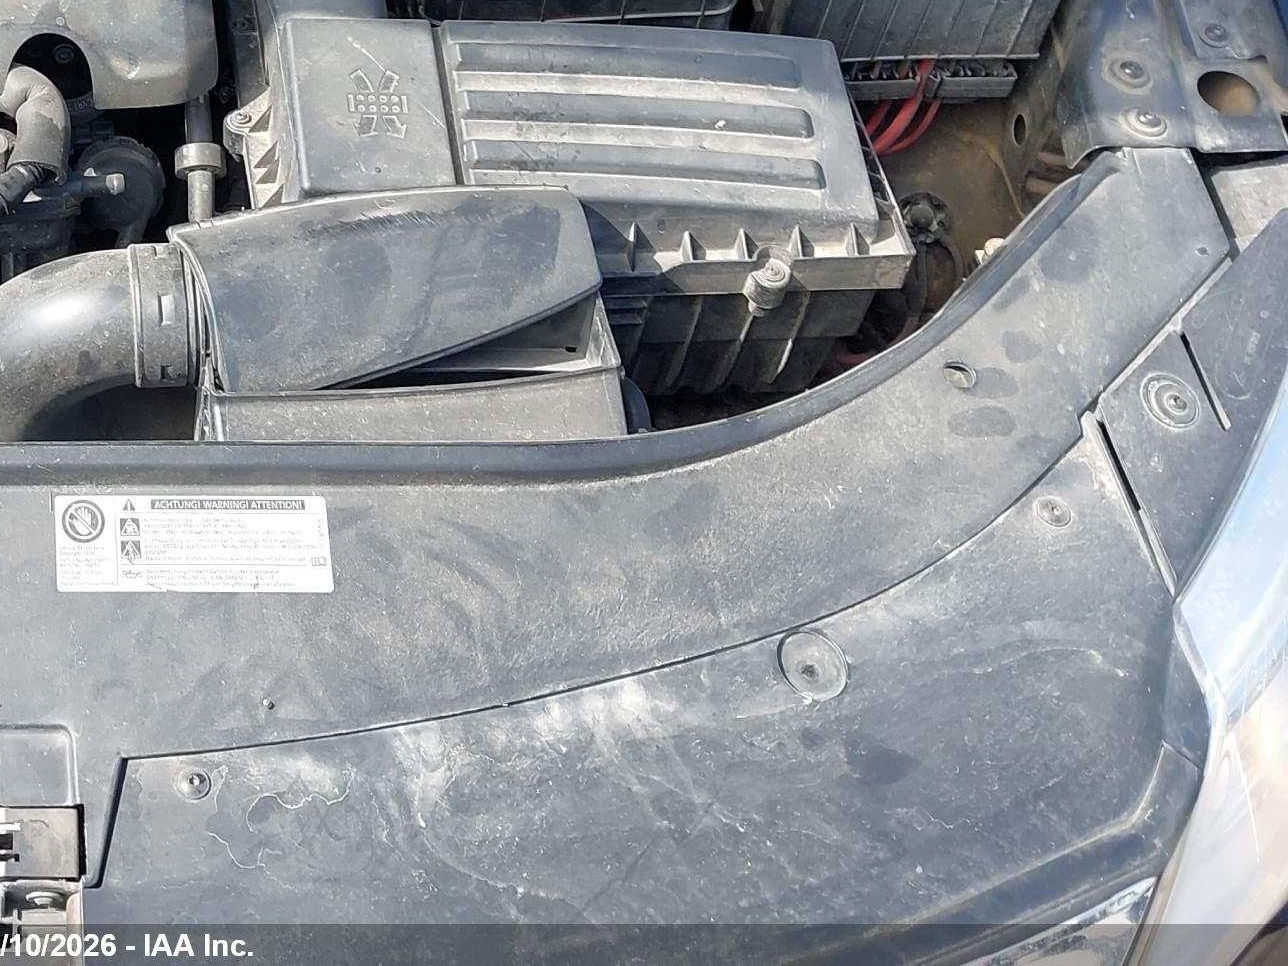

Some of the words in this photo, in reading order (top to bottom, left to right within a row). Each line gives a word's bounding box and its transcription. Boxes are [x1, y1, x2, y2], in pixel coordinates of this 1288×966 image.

[154, 500, 201, 510] ACHTUNG!
[203, 500, 249, 510] WARNING!
[250, 500, 303, 511] ATTENTION!
